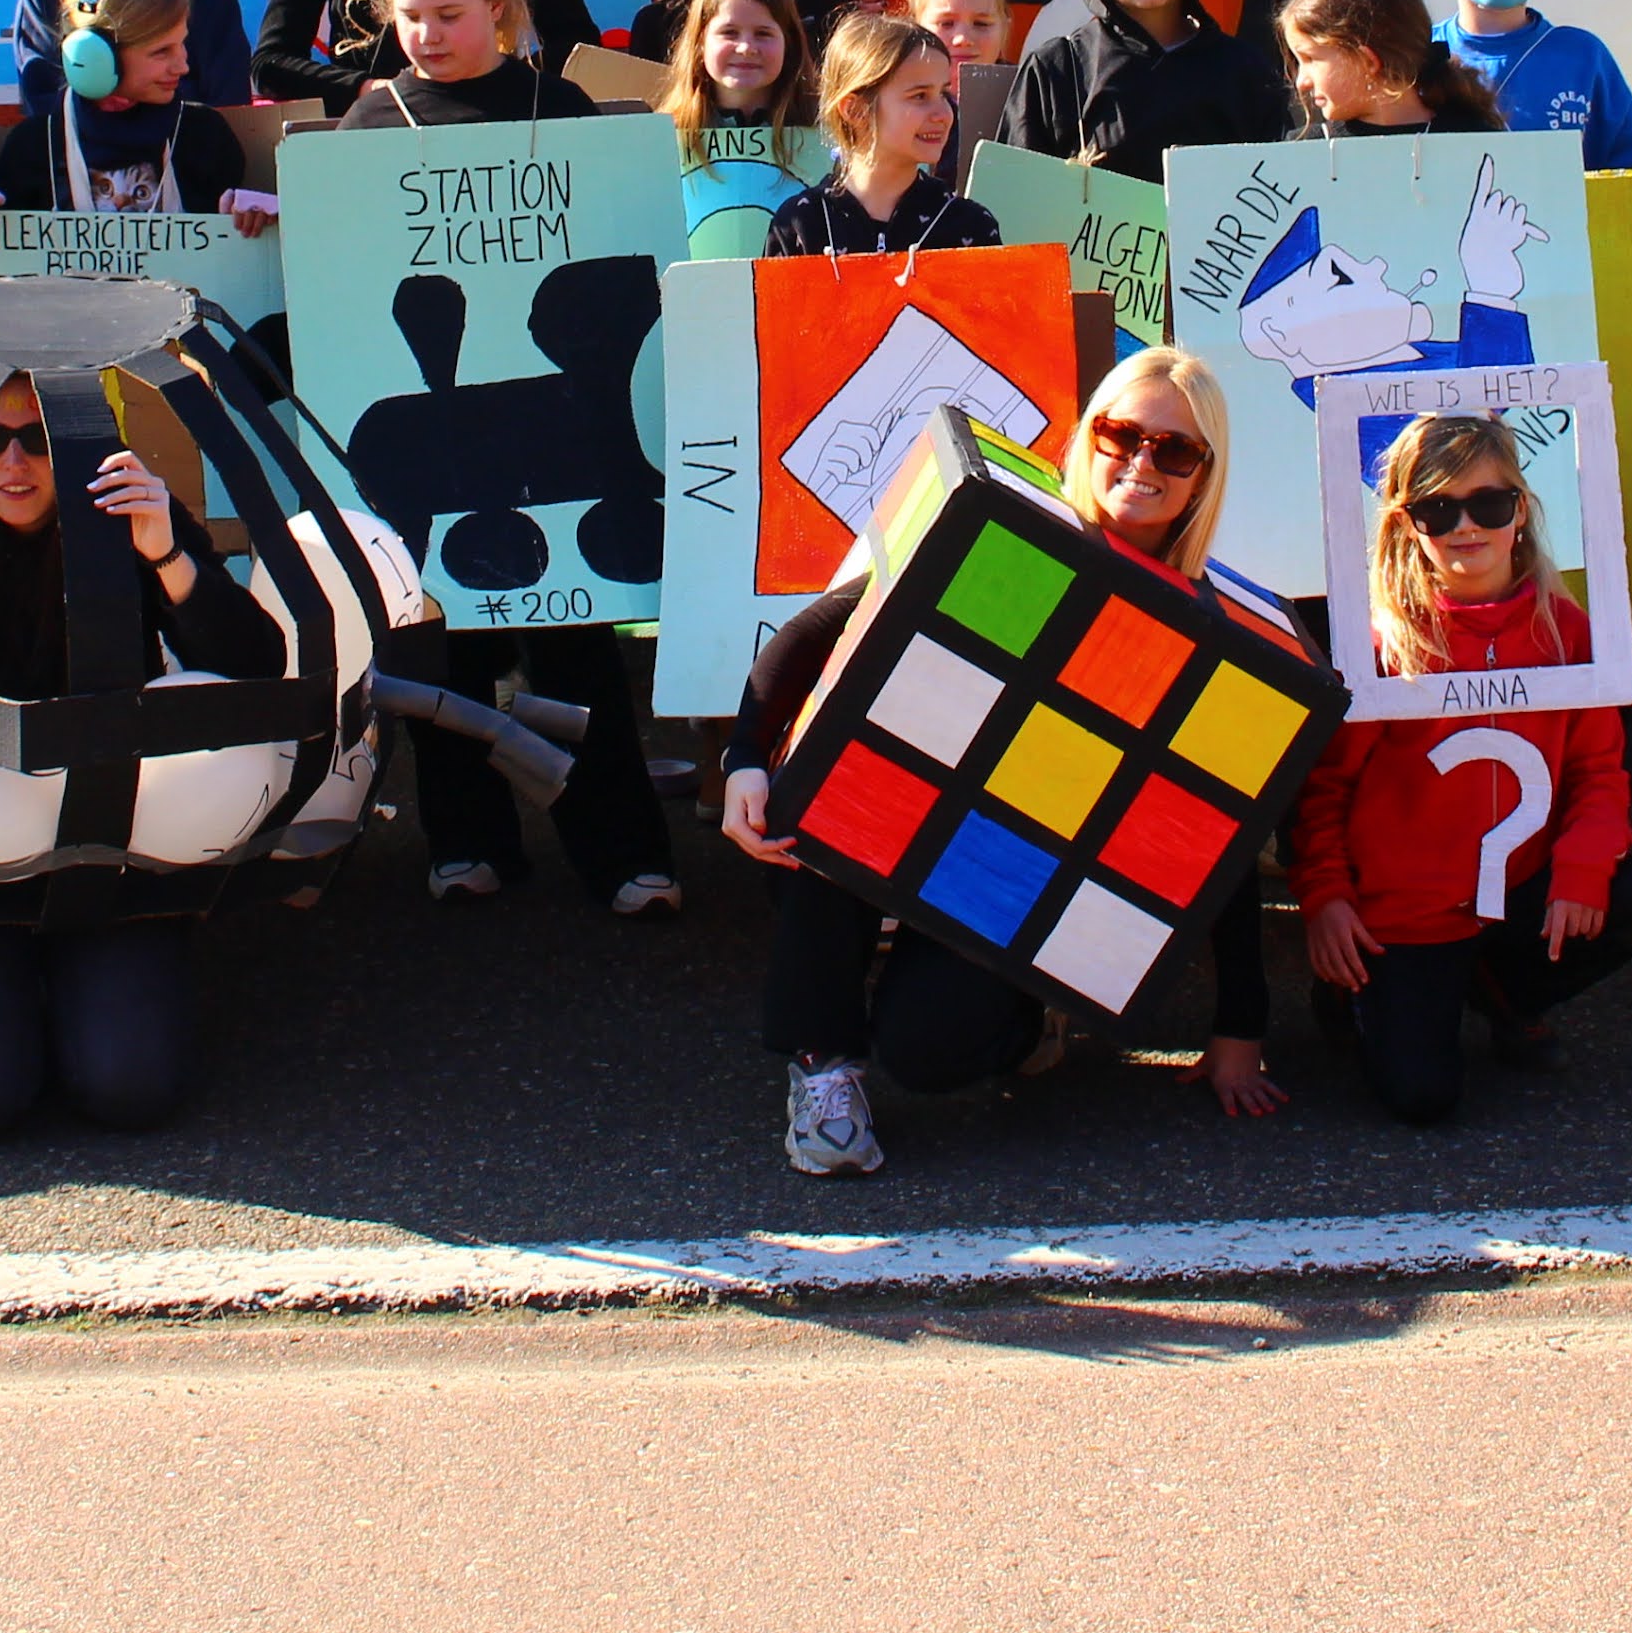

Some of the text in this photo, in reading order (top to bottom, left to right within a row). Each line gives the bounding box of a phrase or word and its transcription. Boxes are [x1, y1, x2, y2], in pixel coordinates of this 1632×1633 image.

[1179, 159, 1301, 314] NAAR DE
[1365, 381, 1416, 413] WIE
[1435, 380, 1461, 408] IS
[1442, 674, 1530, 711] ANNA
